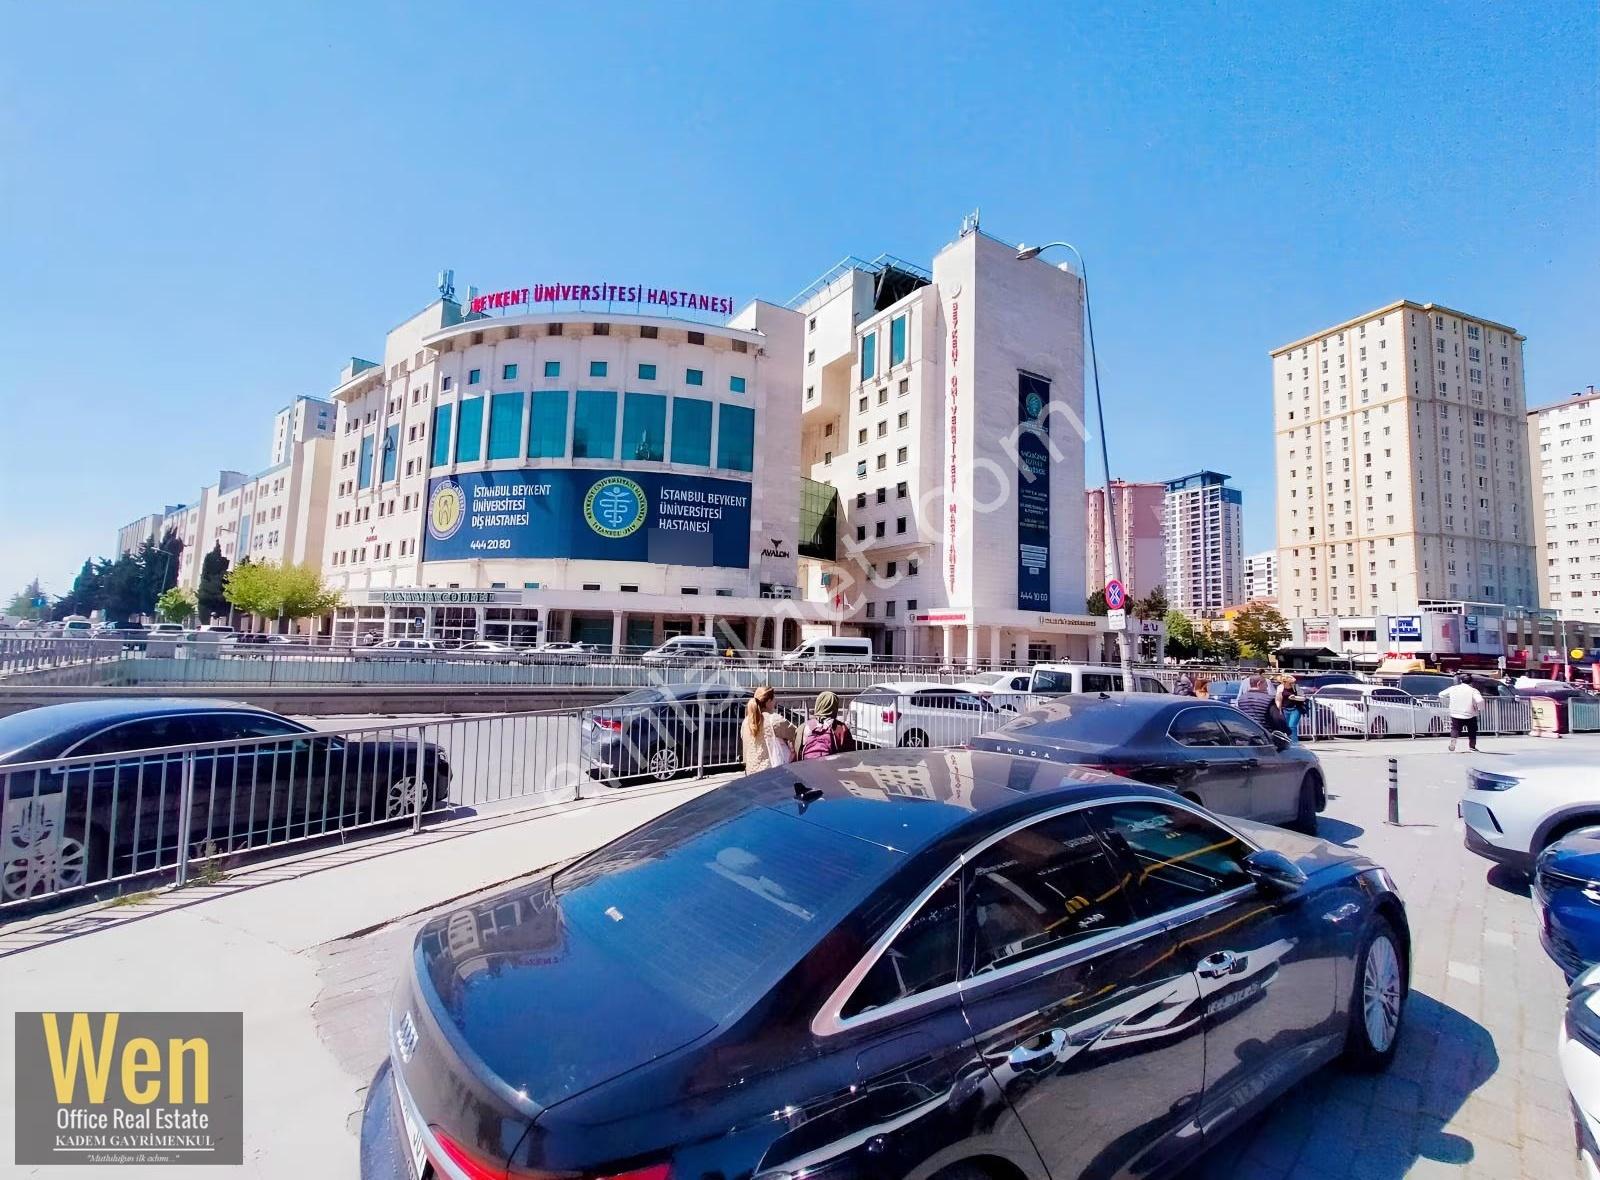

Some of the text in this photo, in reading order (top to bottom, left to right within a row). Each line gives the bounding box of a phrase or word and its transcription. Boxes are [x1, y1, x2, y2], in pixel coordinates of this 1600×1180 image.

[472, 282, 733, 315] BEYKENT ÜNİVERSİTESİ HASTANESİ
[474, 484, 513, 498] İSTANBUL
[513, 484, 552, 496] BEYKENT
[660, 486, 748, 507] İSTANBUL BEYKENT
[473, 498, 526, 512] ÜNİVERSİTESİ
[659, 501, 722, 520] ÜNİVERSİTESİ
[471, 512, 529, 529] DİŞ HASTANESİ
[659, 518, 710, 533] HASTANESİ
[470, 540, 511, 550] 444 20 80
[761, 549, 790, 559] AVALON
